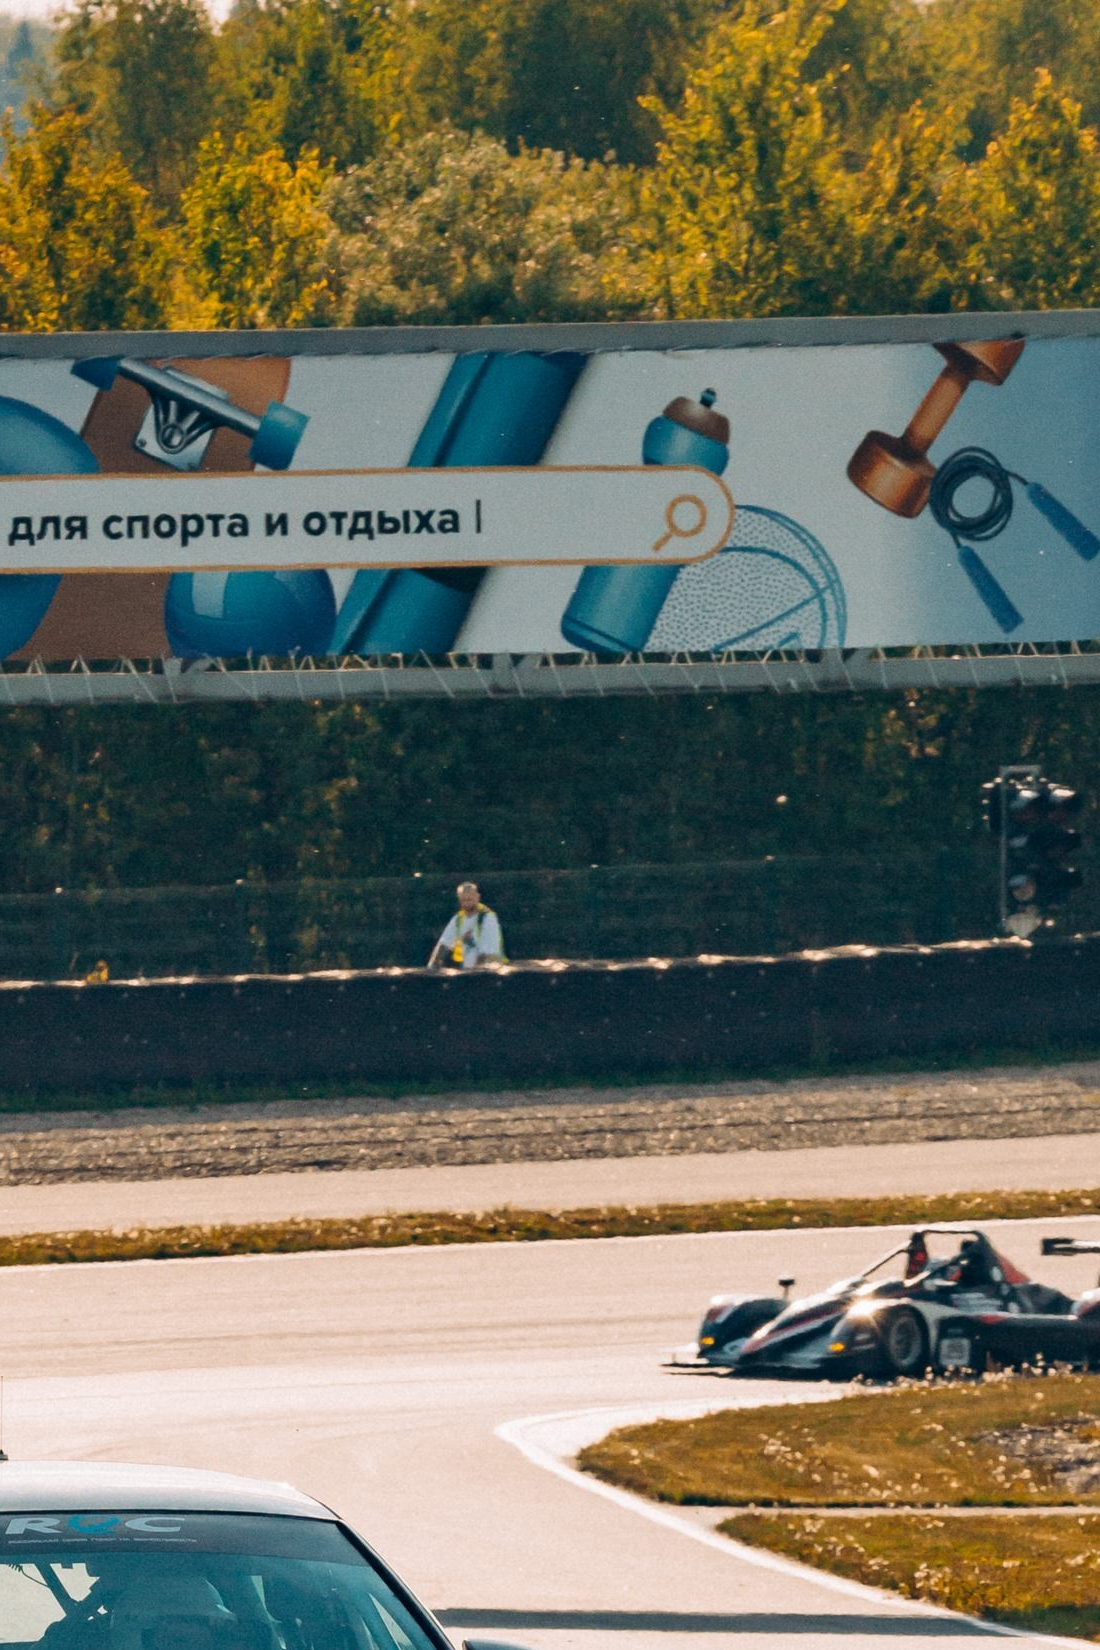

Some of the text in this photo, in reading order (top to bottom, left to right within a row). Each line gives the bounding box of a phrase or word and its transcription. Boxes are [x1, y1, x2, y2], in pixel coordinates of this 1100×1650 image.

[8, 514, 88, 546] для
[102, 512, 250, 547] спорта
[265, 512, 289, 537] и
[302, 508, 460, 541] отдыха
